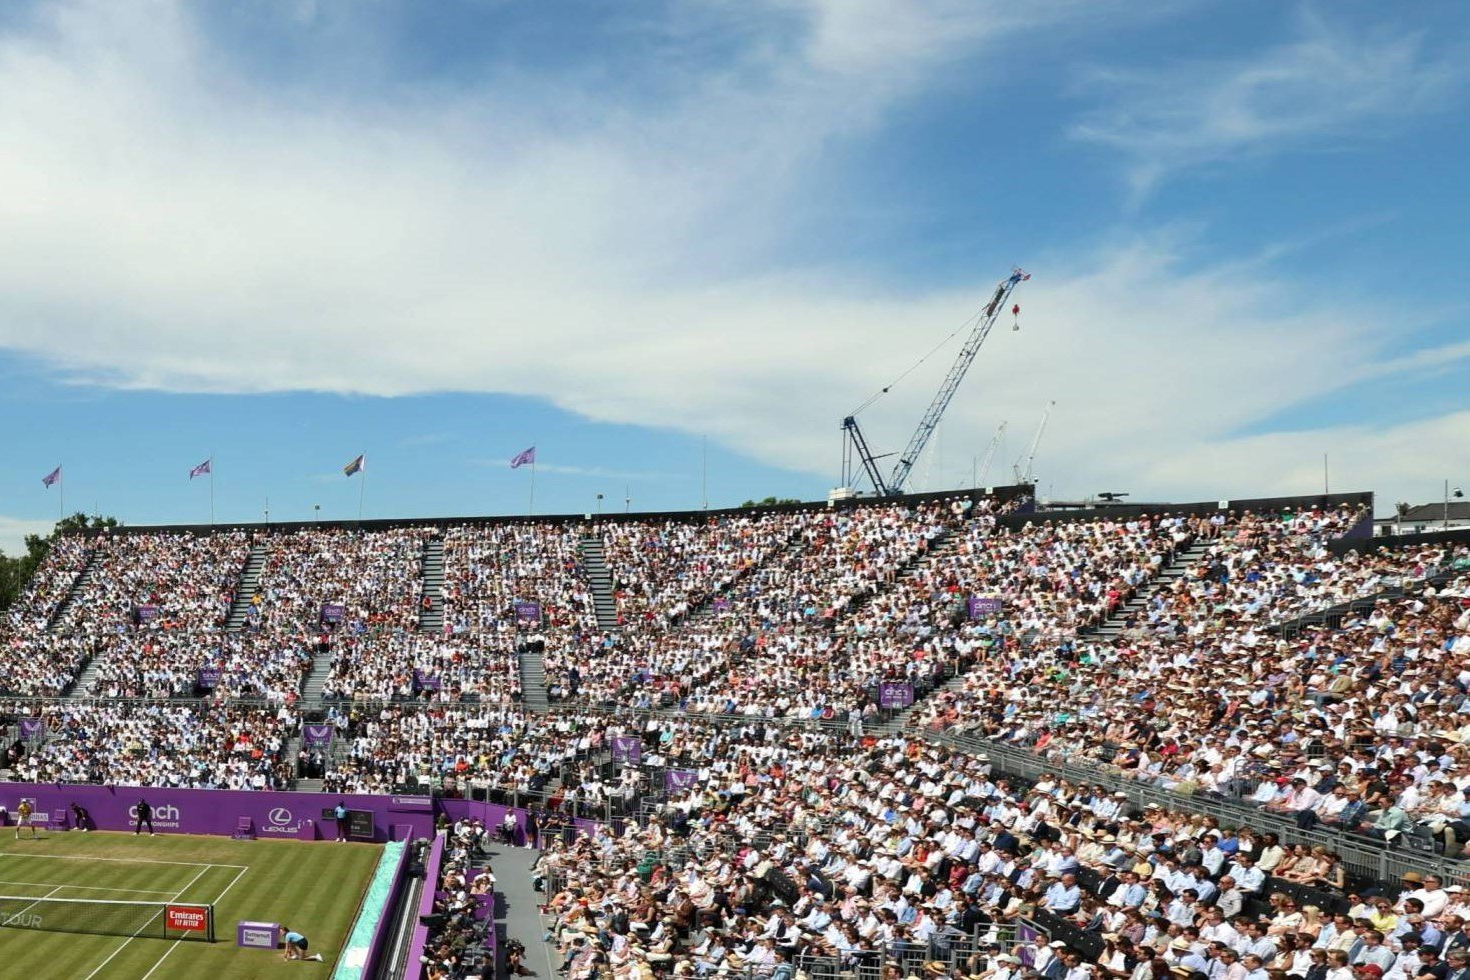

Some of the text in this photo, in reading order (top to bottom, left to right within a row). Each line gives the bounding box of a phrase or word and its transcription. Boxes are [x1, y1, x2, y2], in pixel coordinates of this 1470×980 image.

[129, 804, 180, 820] cnch
[262, 825, 298, 834] LEXUS
[1, 911, 43, 928] TOUR
[170, 910, 204, 921] Emirates
